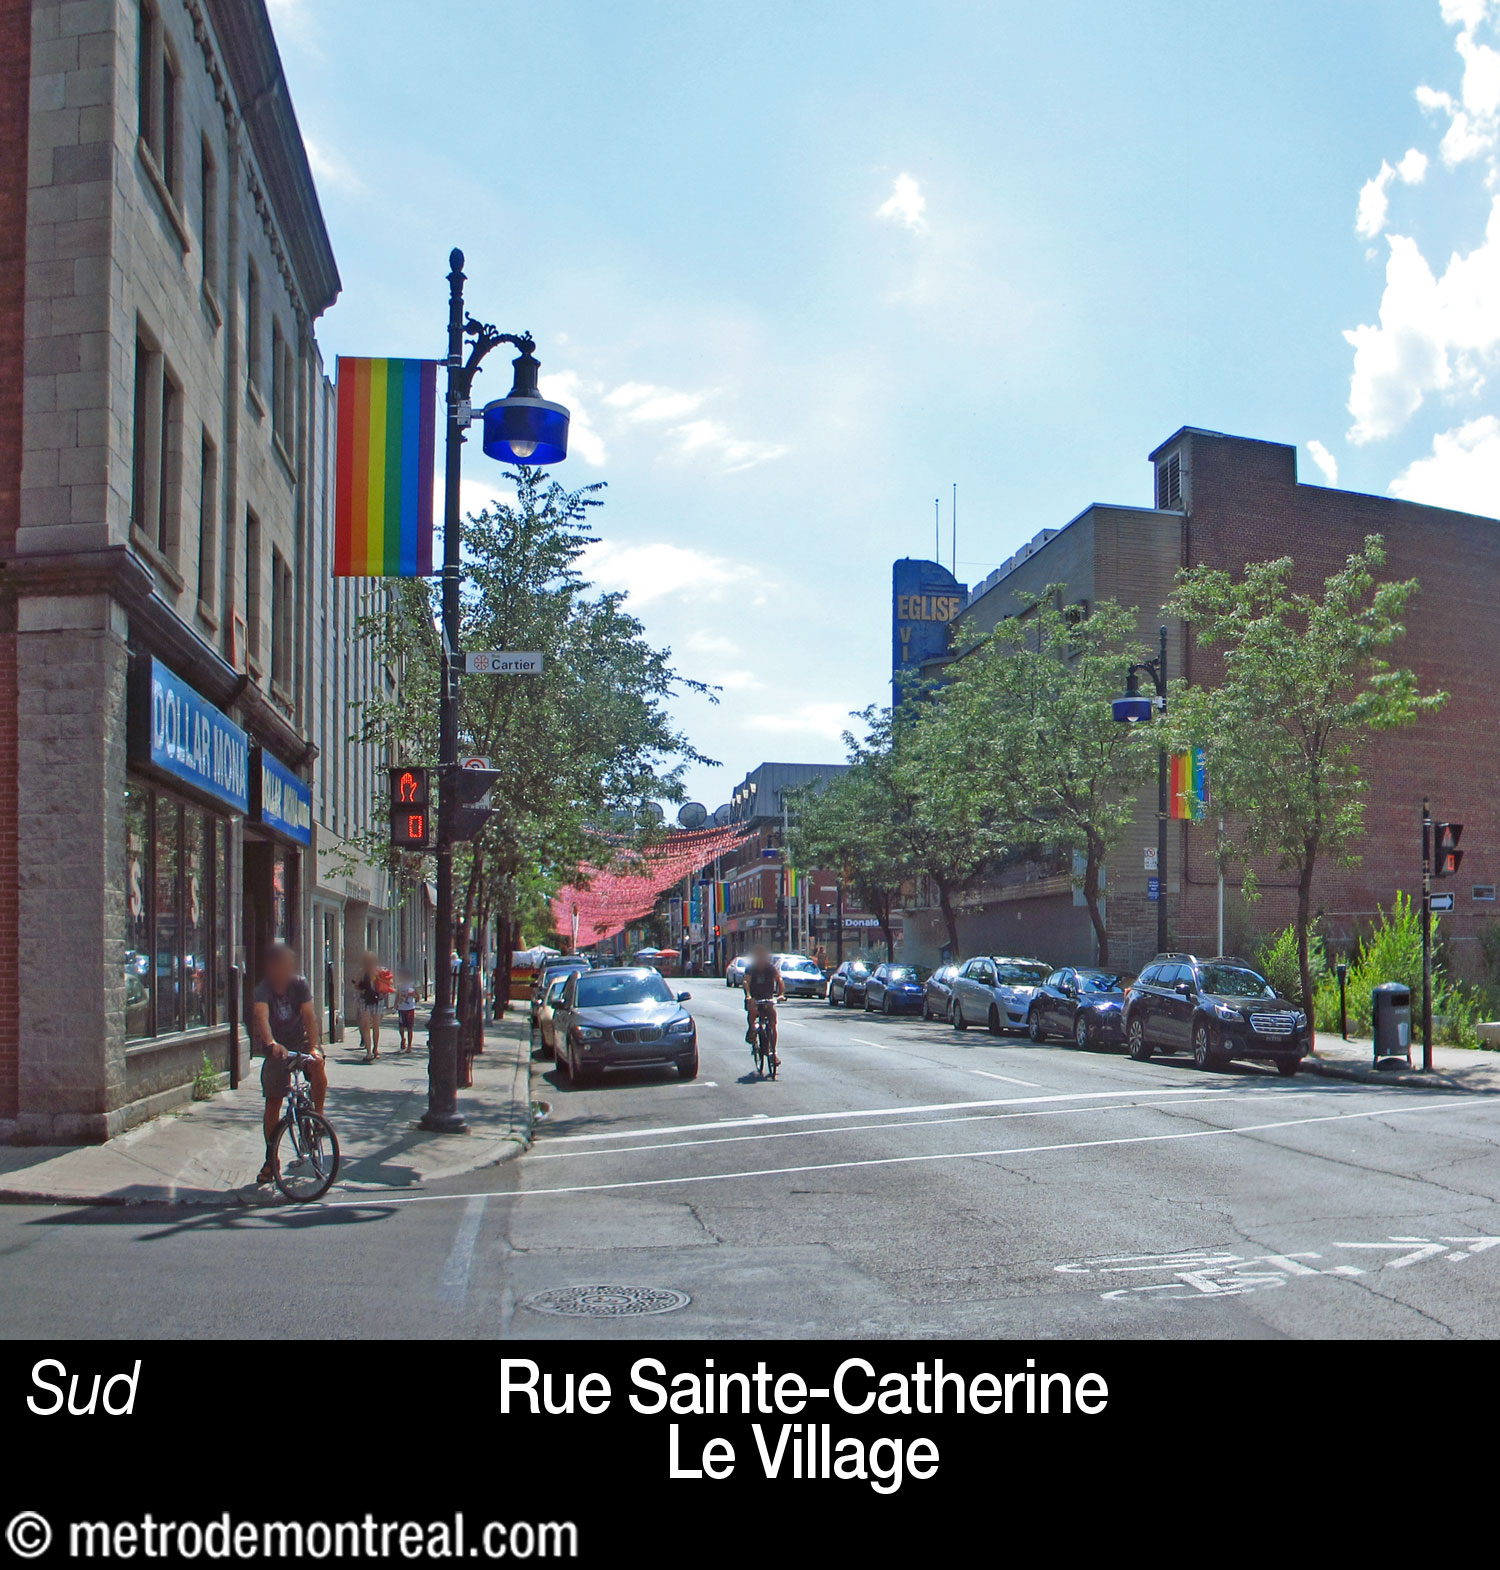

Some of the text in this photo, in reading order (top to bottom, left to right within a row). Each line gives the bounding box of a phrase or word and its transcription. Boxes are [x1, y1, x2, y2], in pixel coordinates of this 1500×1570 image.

[492, 659, 536, 670] Cartier
[153, 679, 247, 800] DOLLAR MONA
